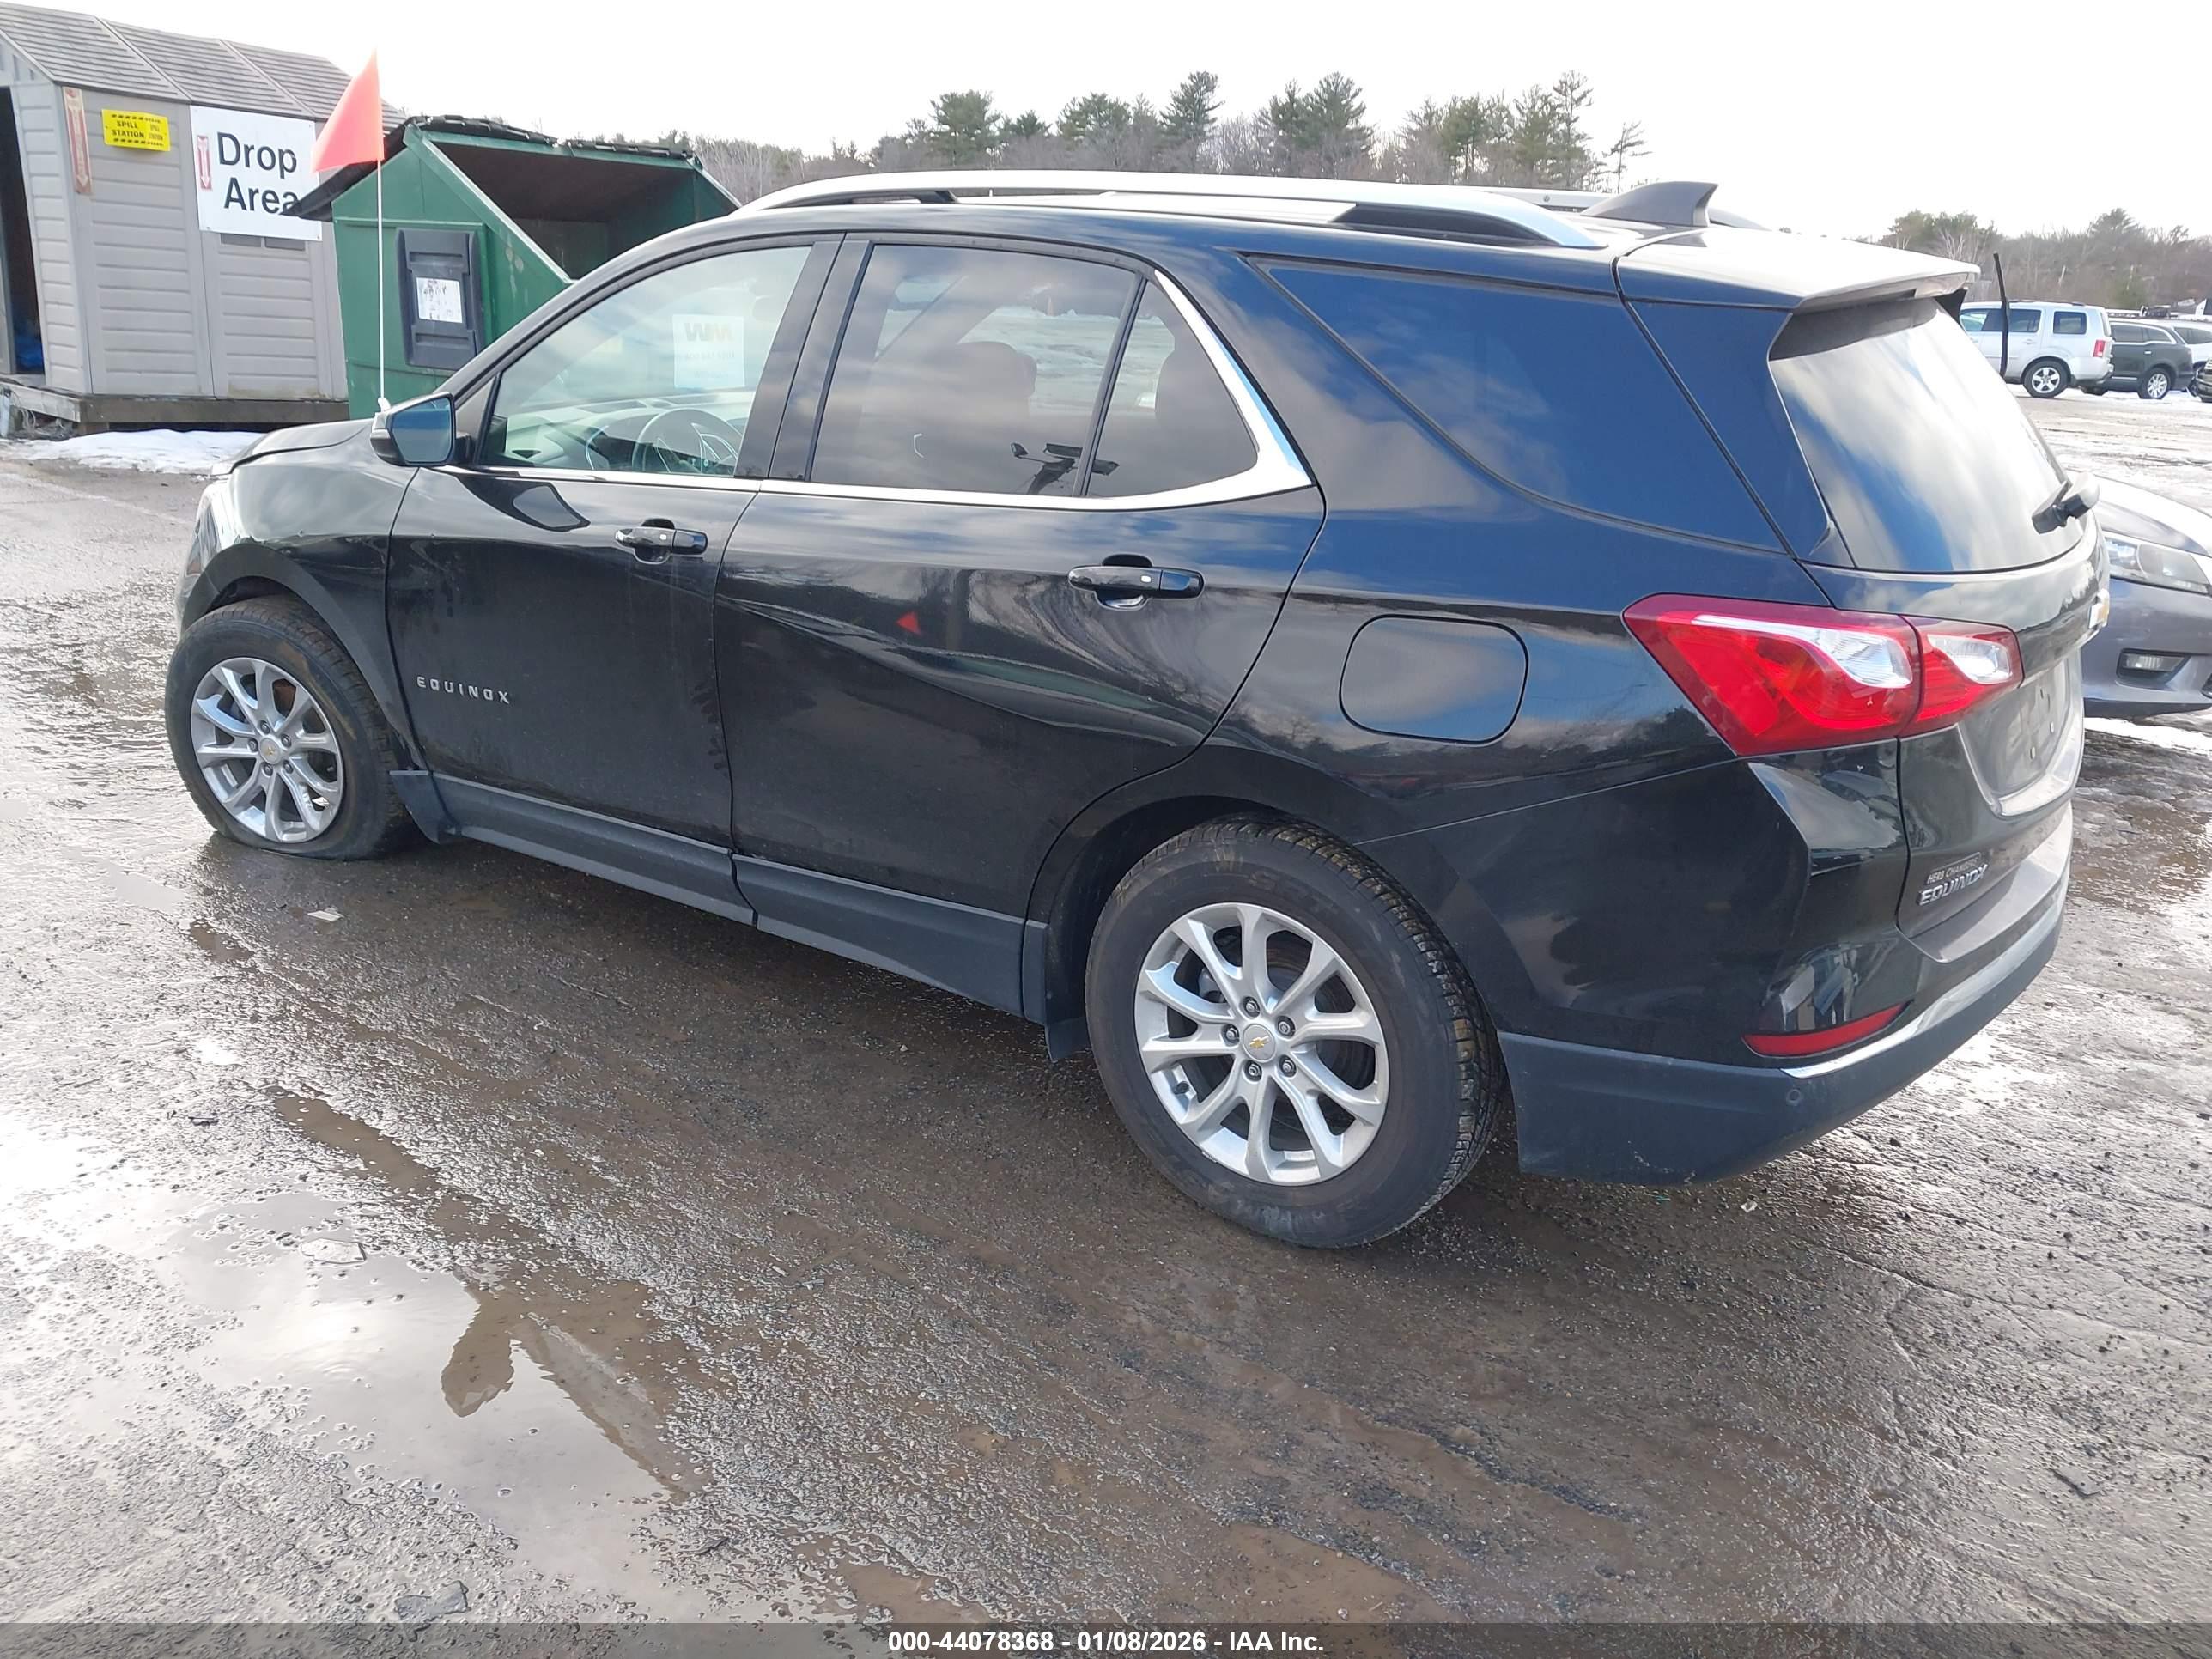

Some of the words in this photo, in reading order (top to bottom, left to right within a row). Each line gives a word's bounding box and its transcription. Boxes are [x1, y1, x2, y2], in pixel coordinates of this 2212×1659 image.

[112, 129, 144, 138] STATION
[216, 131, 297, 179] Drop
[223, 177, 299, 214] Area
[416, 676, 510, 704] EQUINOX
[1918, 864, 1989, 906] EQUINOX
